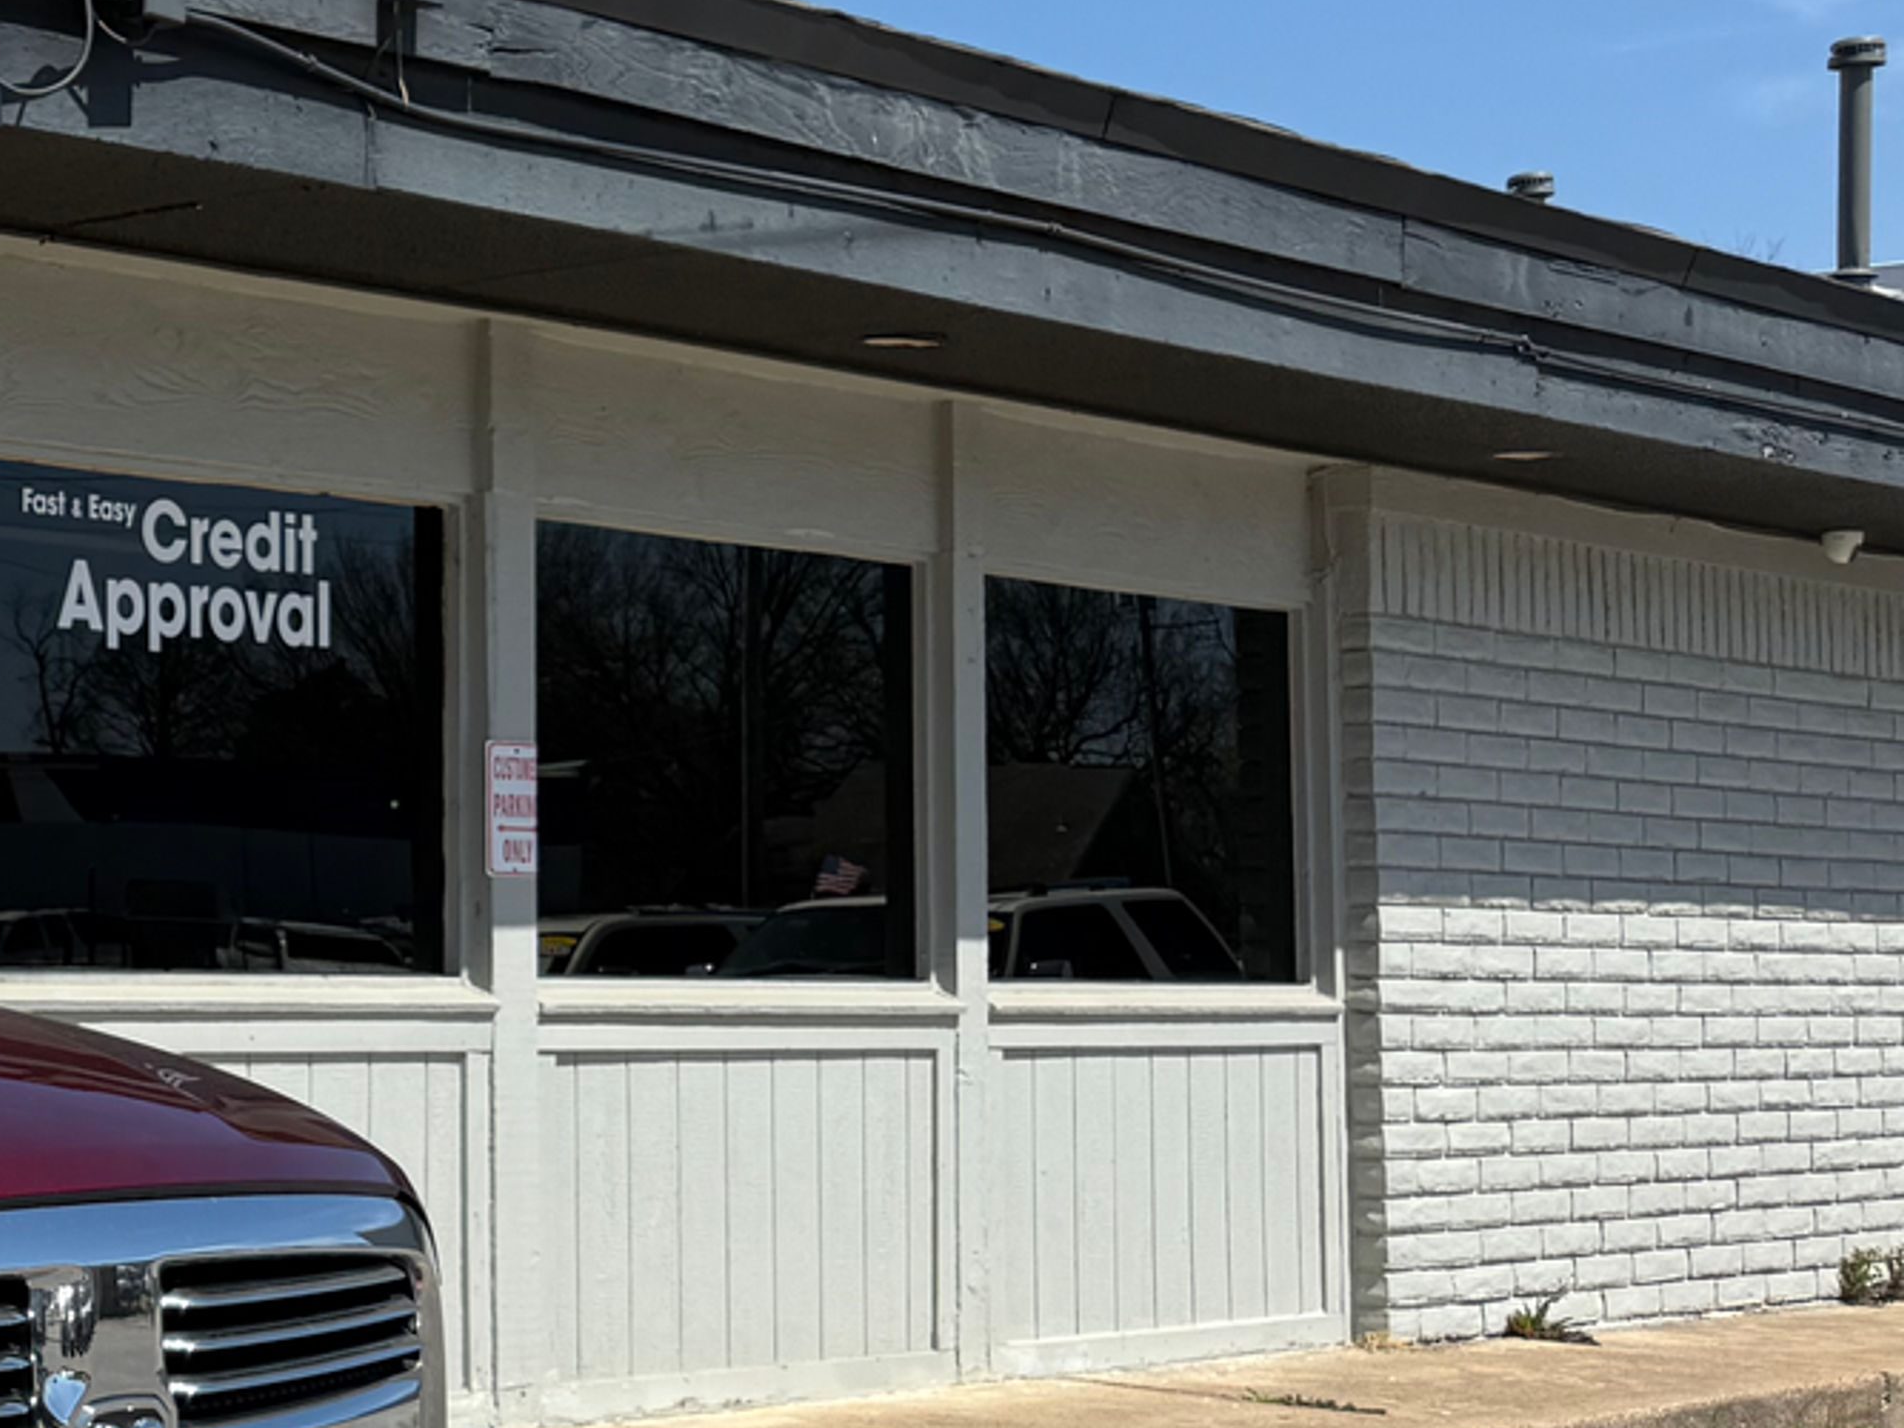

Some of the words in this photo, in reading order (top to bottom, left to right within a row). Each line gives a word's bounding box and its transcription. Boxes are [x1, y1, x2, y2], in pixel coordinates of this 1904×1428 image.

[21, 487, 66, 517] Fast
[71, 498, 82, 518] &
[88, 493, 136, 529] Easy
[142, 498, 318, 576] Credit
[57, 558, 331, 653] Approval
[502, 838, 532, 864] ONLY
